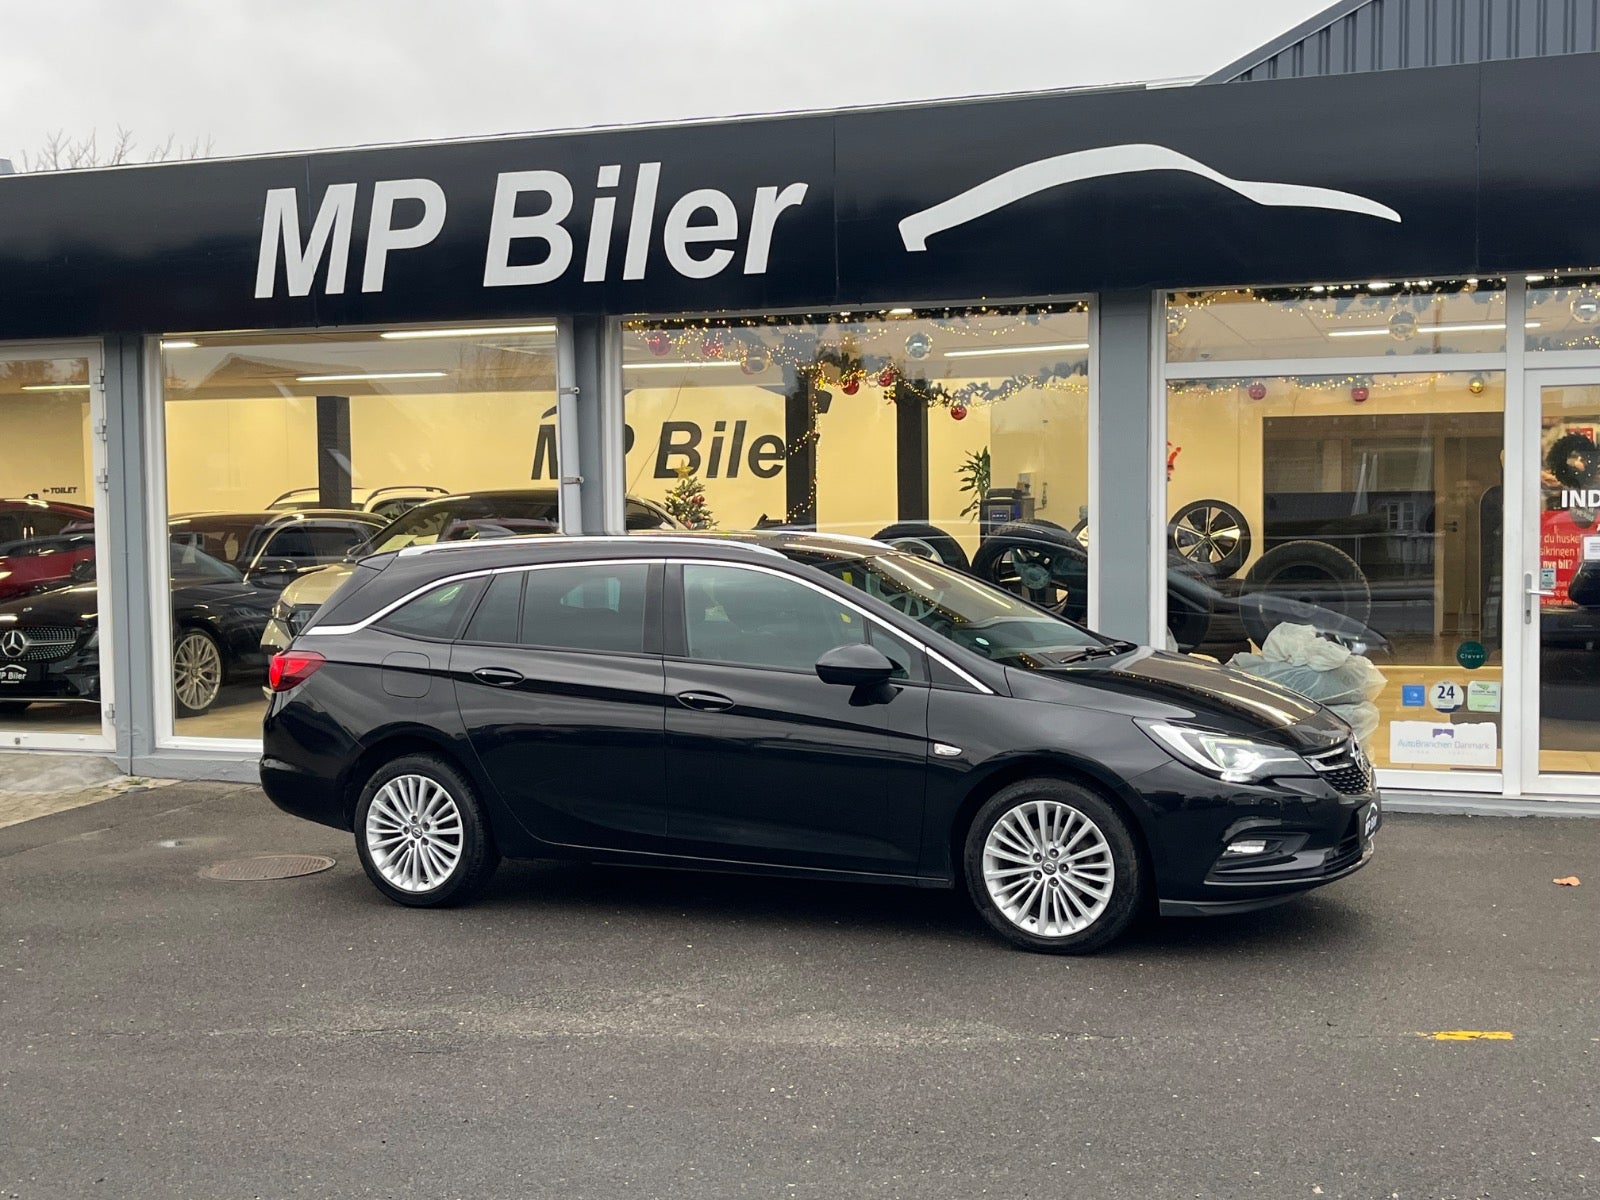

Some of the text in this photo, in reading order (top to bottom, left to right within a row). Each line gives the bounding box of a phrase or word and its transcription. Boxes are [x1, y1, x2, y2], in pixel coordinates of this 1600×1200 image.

[255, 162, 808, 298] MP Biler
[654, 420, 820, 479] Bile
[1437, 685, 1455, 699] 24
[1454, 741, 1490, 750] Danmark
